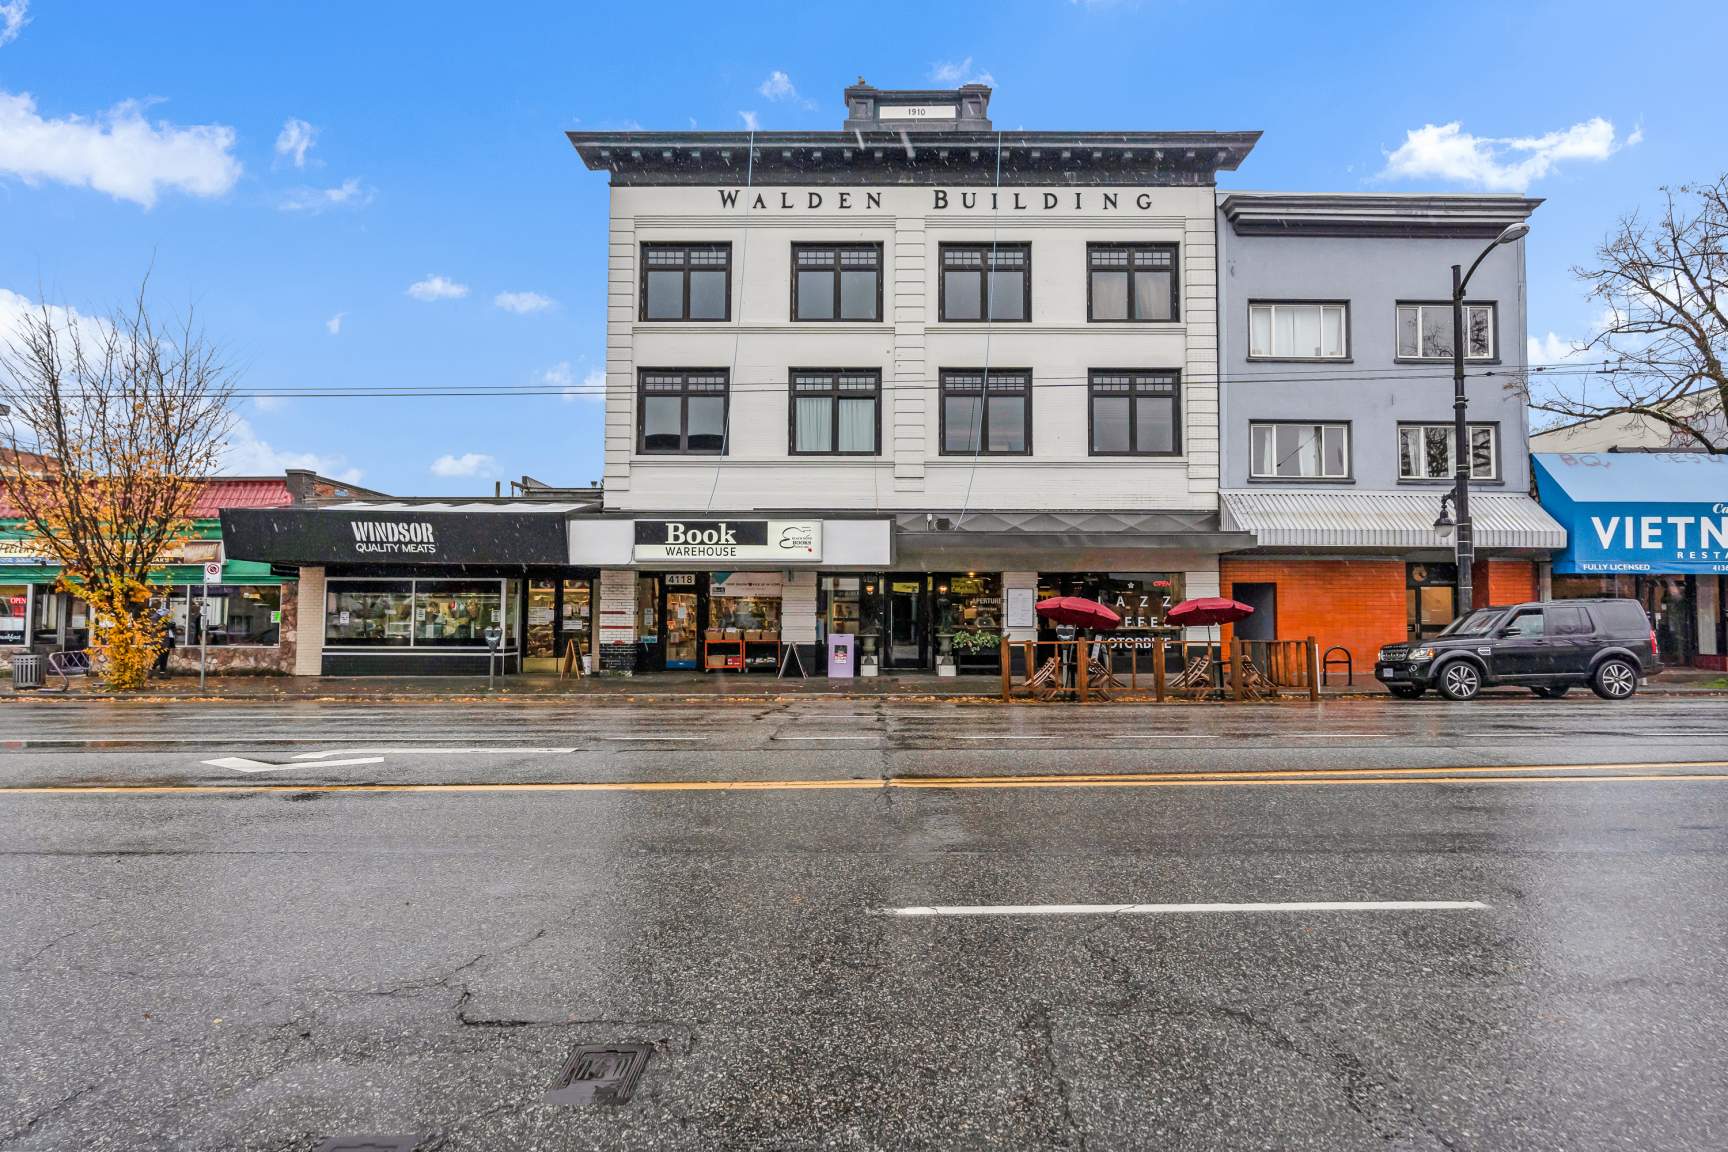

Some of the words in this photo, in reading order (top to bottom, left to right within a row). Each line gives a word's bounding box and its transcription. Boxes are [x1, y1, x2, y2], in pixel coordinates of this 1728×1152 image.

[908, 108, 926, 116] 1910
[718, 189, 882, 209] WALDEN
[932, 189, 1152, 210] BUILDING
[350, 521, 435, 543] WINDSOR
[665, 522, 737, 544] Book
[1590, 516, 1728, 549] VIETN
[355, 543, 399, 553] QUALITY
[401, 543, 437, 553] MEATS
[665, 546, 737, 557] WAREHOUSE
[1583, 563, 1608, 571] FULLY
[1610, 563, 1650, 571] LICENSED
[668, 575, 693, 584] 4118
[1107, 637, 1172, 649] OTORBIE
